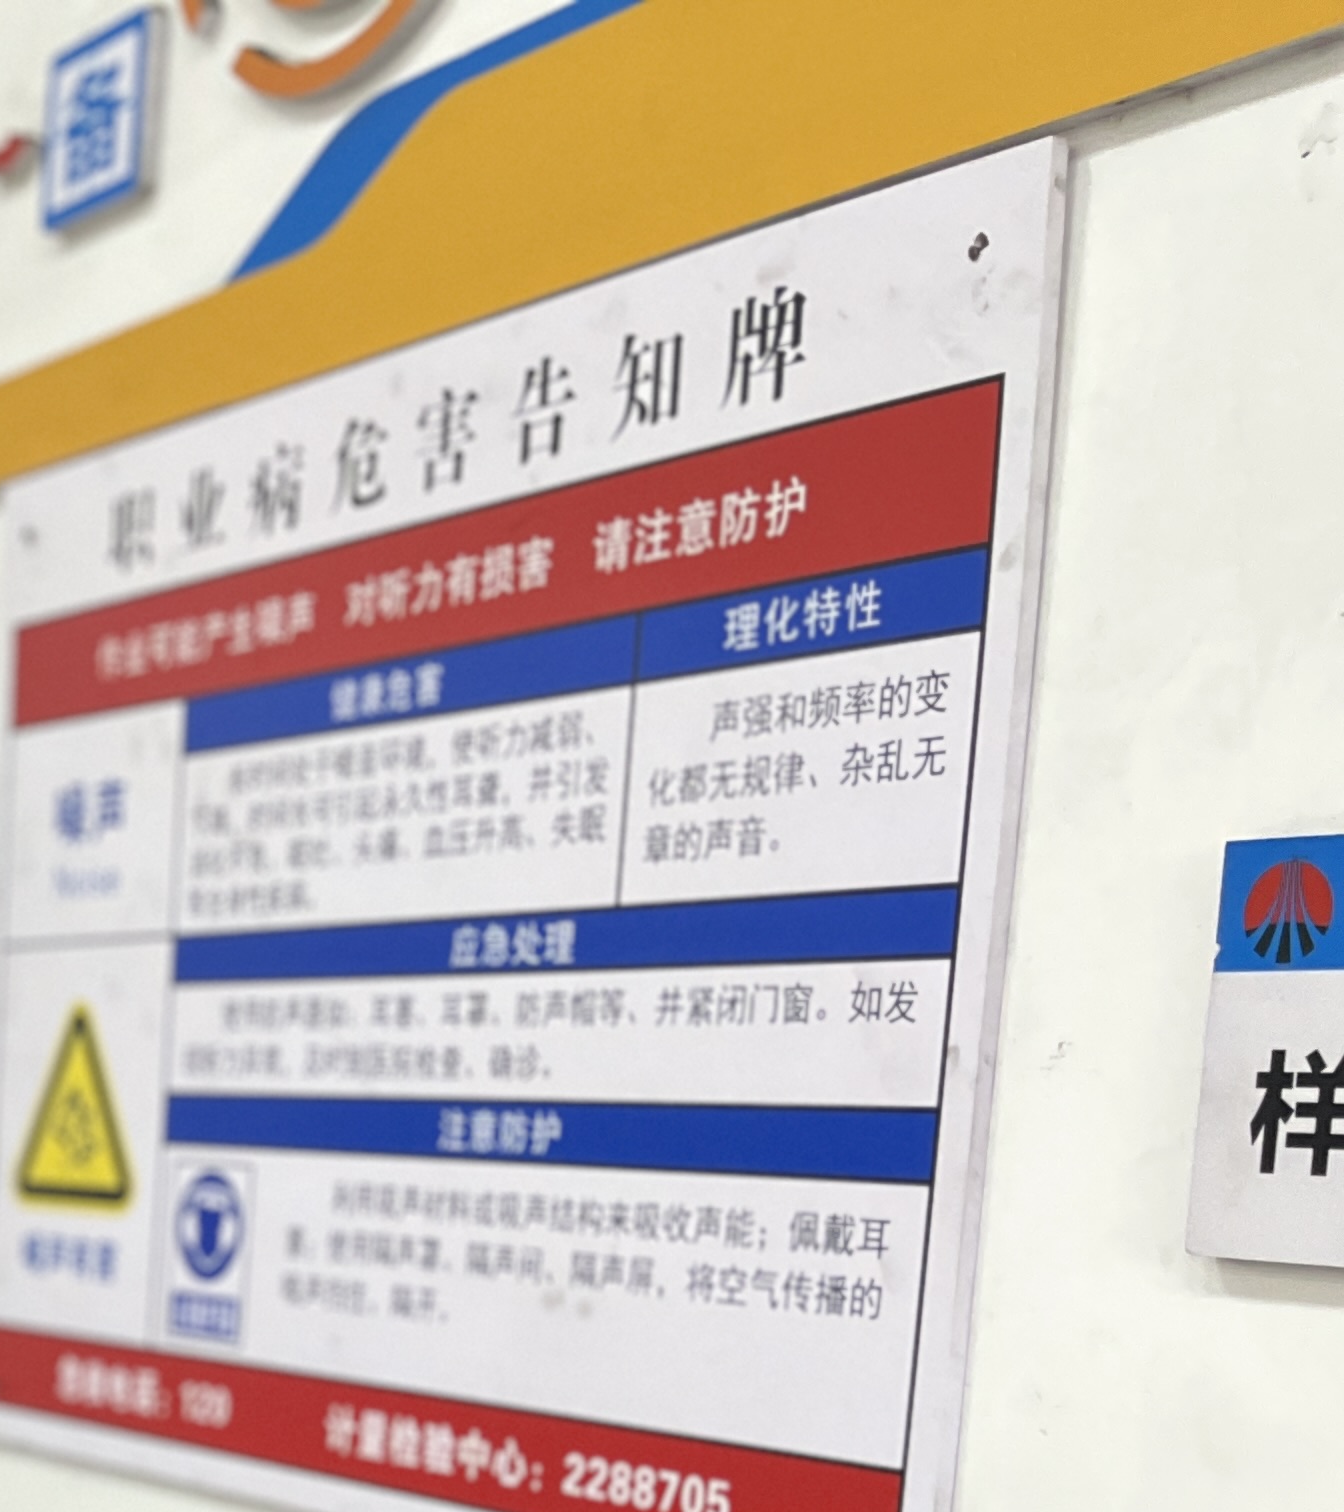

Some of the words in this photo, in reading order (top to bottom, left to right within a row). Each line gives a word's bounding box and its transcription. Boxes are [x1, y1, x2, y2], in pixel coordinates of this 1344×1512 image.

[106, 285, 807, 574] 职业病危害告知牌
[342, 533, 555, 628] 对听力有损害
[593, 476, 807, 574] 请注意防护
[723, 580, 882, 651] 理化特性
[329, 662, 445, 722] 健康危害
[710, 670, 951, 743] 声强和频率的变
[648, 736, 947, 807] 化都无规律、杂乱无
[643, 816, 781, 865] 章的声音。
[449, 919, 578, 969] 应急处理
[436, 1108, 564, 1155] 注意防护
